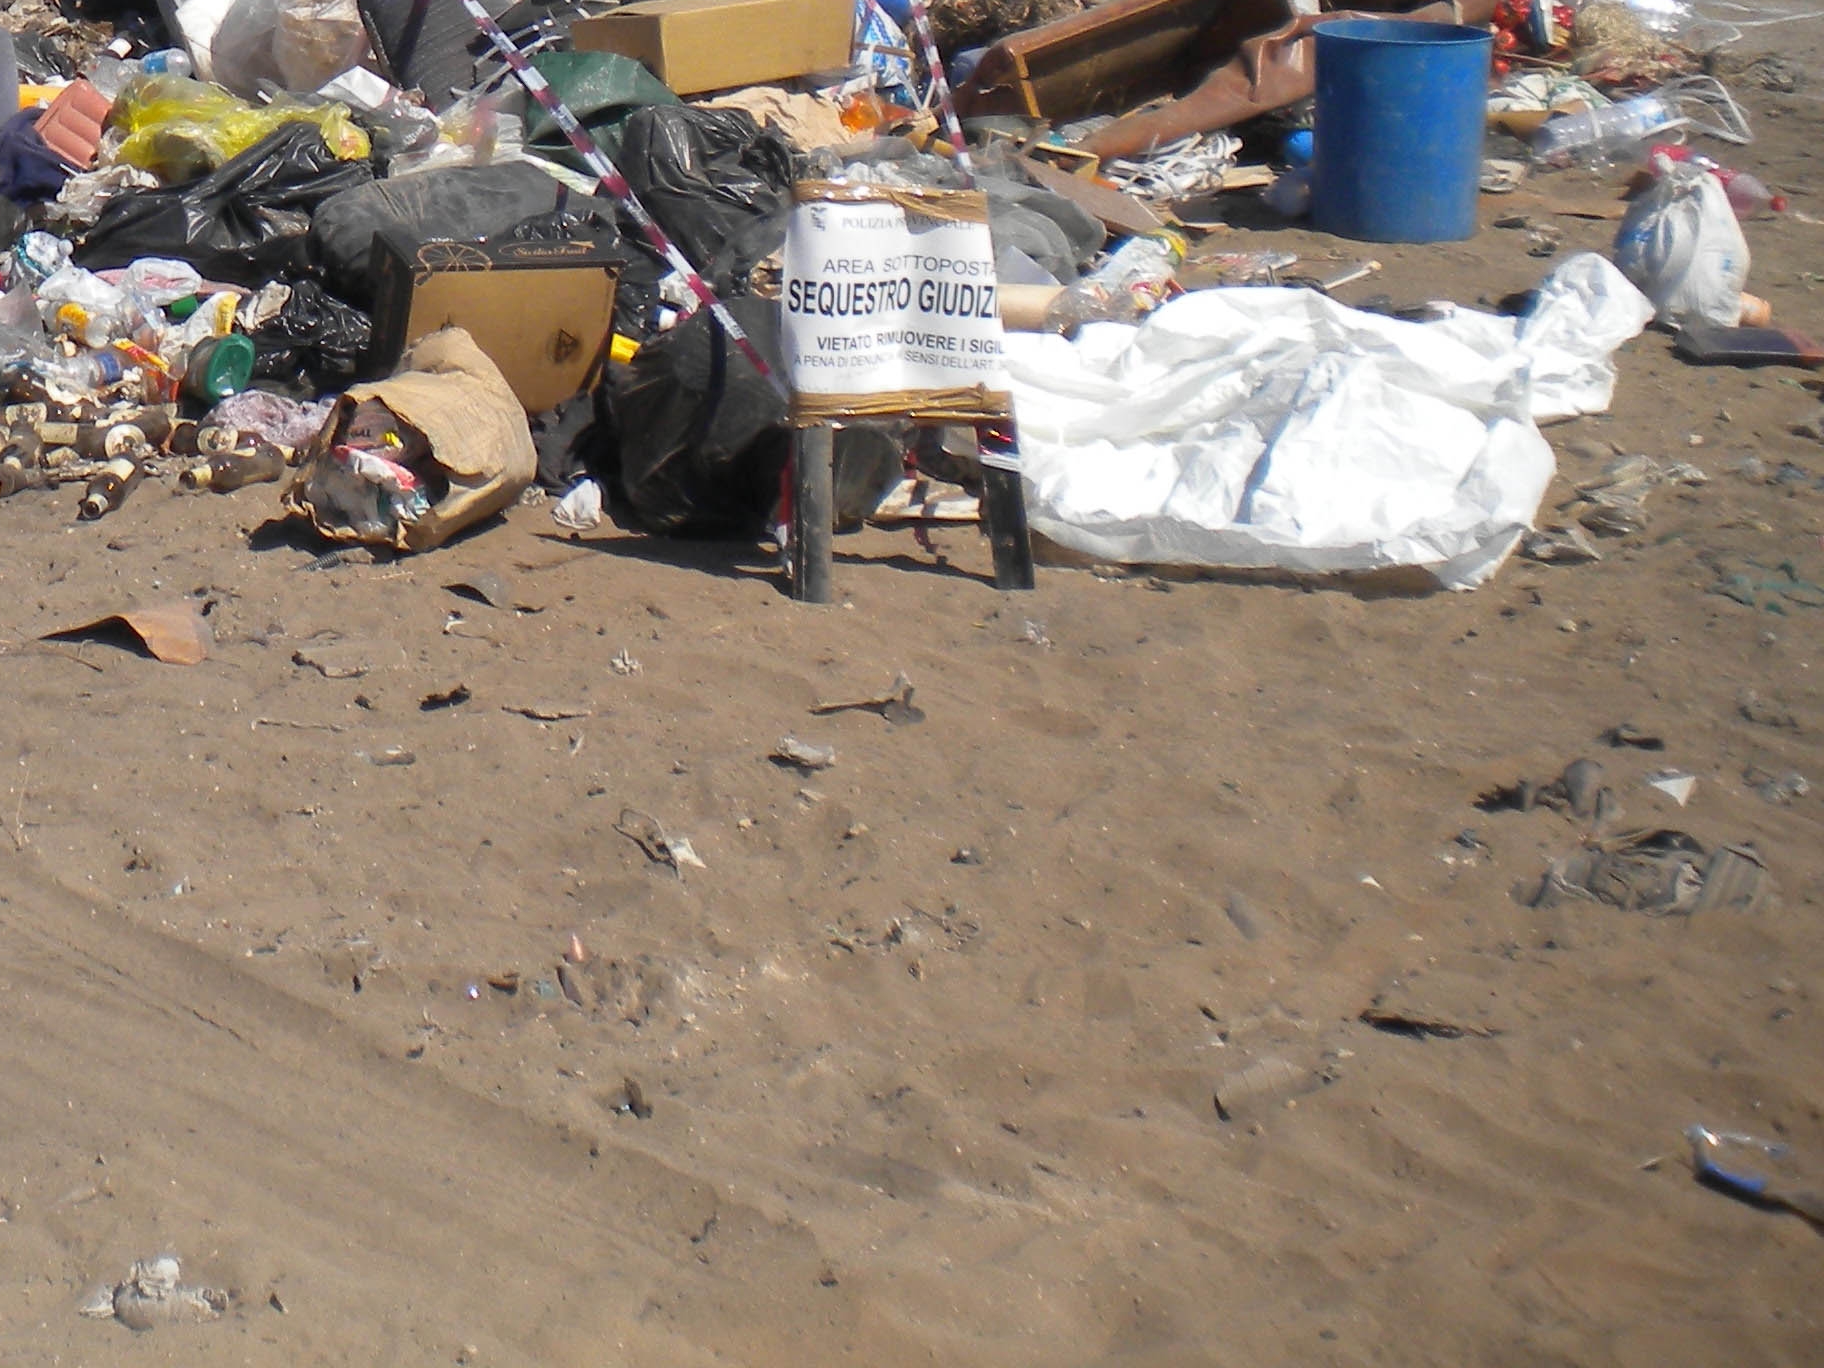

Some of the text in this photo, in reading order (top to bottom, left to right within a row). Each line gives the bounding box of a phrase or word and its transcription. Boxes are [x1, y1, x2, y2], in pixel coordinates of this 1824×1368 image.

[842, 217, 893, 229] POLIZIA
[823, 258, 874, 274] AREA
[788, 277, 911, 317] SEQUESTRO
[817, 335, 872, 351] VIETATO
[877, 331, 956, 351] RIMUOVERE
[960, 337, 965, 352] I
[794, 354, 802, 365] A
[804, 355, 835, 367] PENA
[904, 350, 939, 365] SENSI
